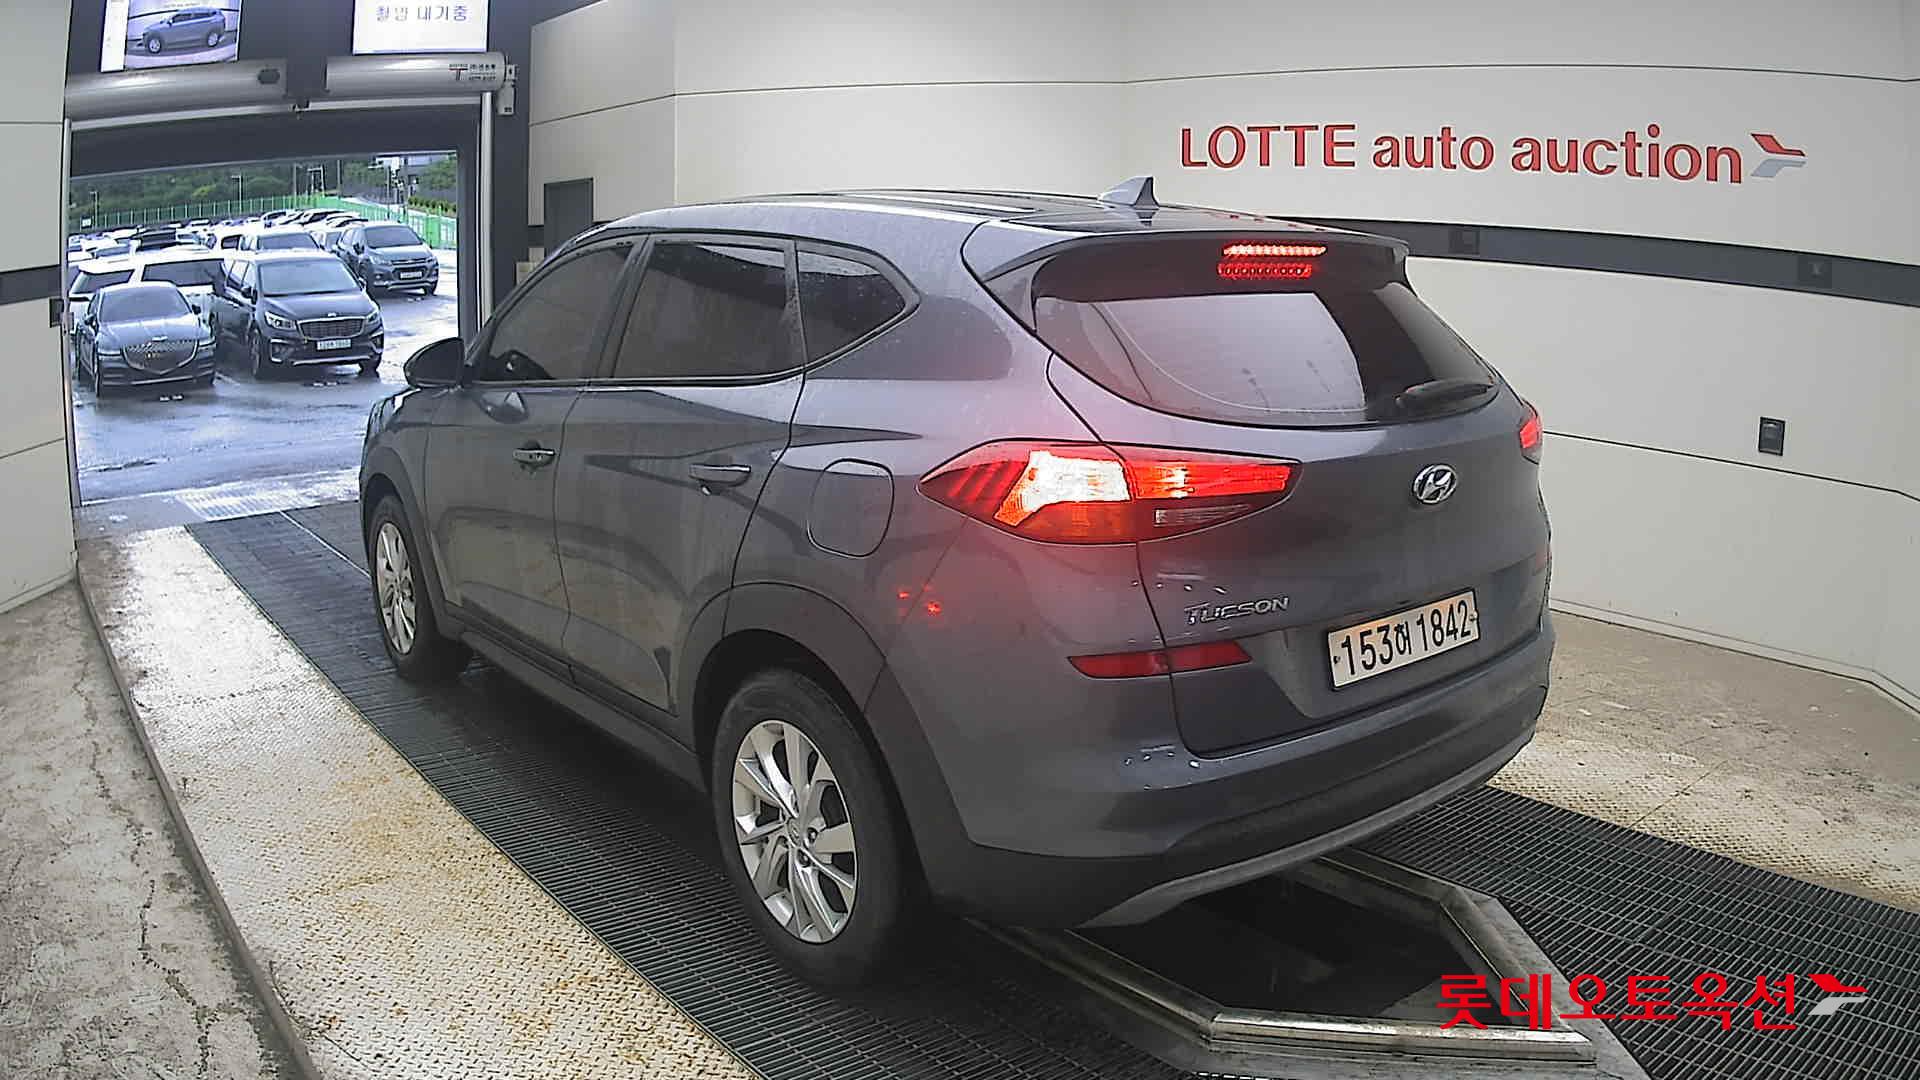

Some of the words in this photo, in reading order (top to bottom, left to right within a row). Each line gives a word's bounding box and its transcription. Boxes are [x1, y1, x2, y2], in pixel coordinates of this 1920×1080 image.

[1180, 123, 1356, 169] LOTTE
[1372, 126, 1495, 170] auto
[1510, 123, 1742, 184] auction
[1184, 597, 1289, 624] TUCSON
